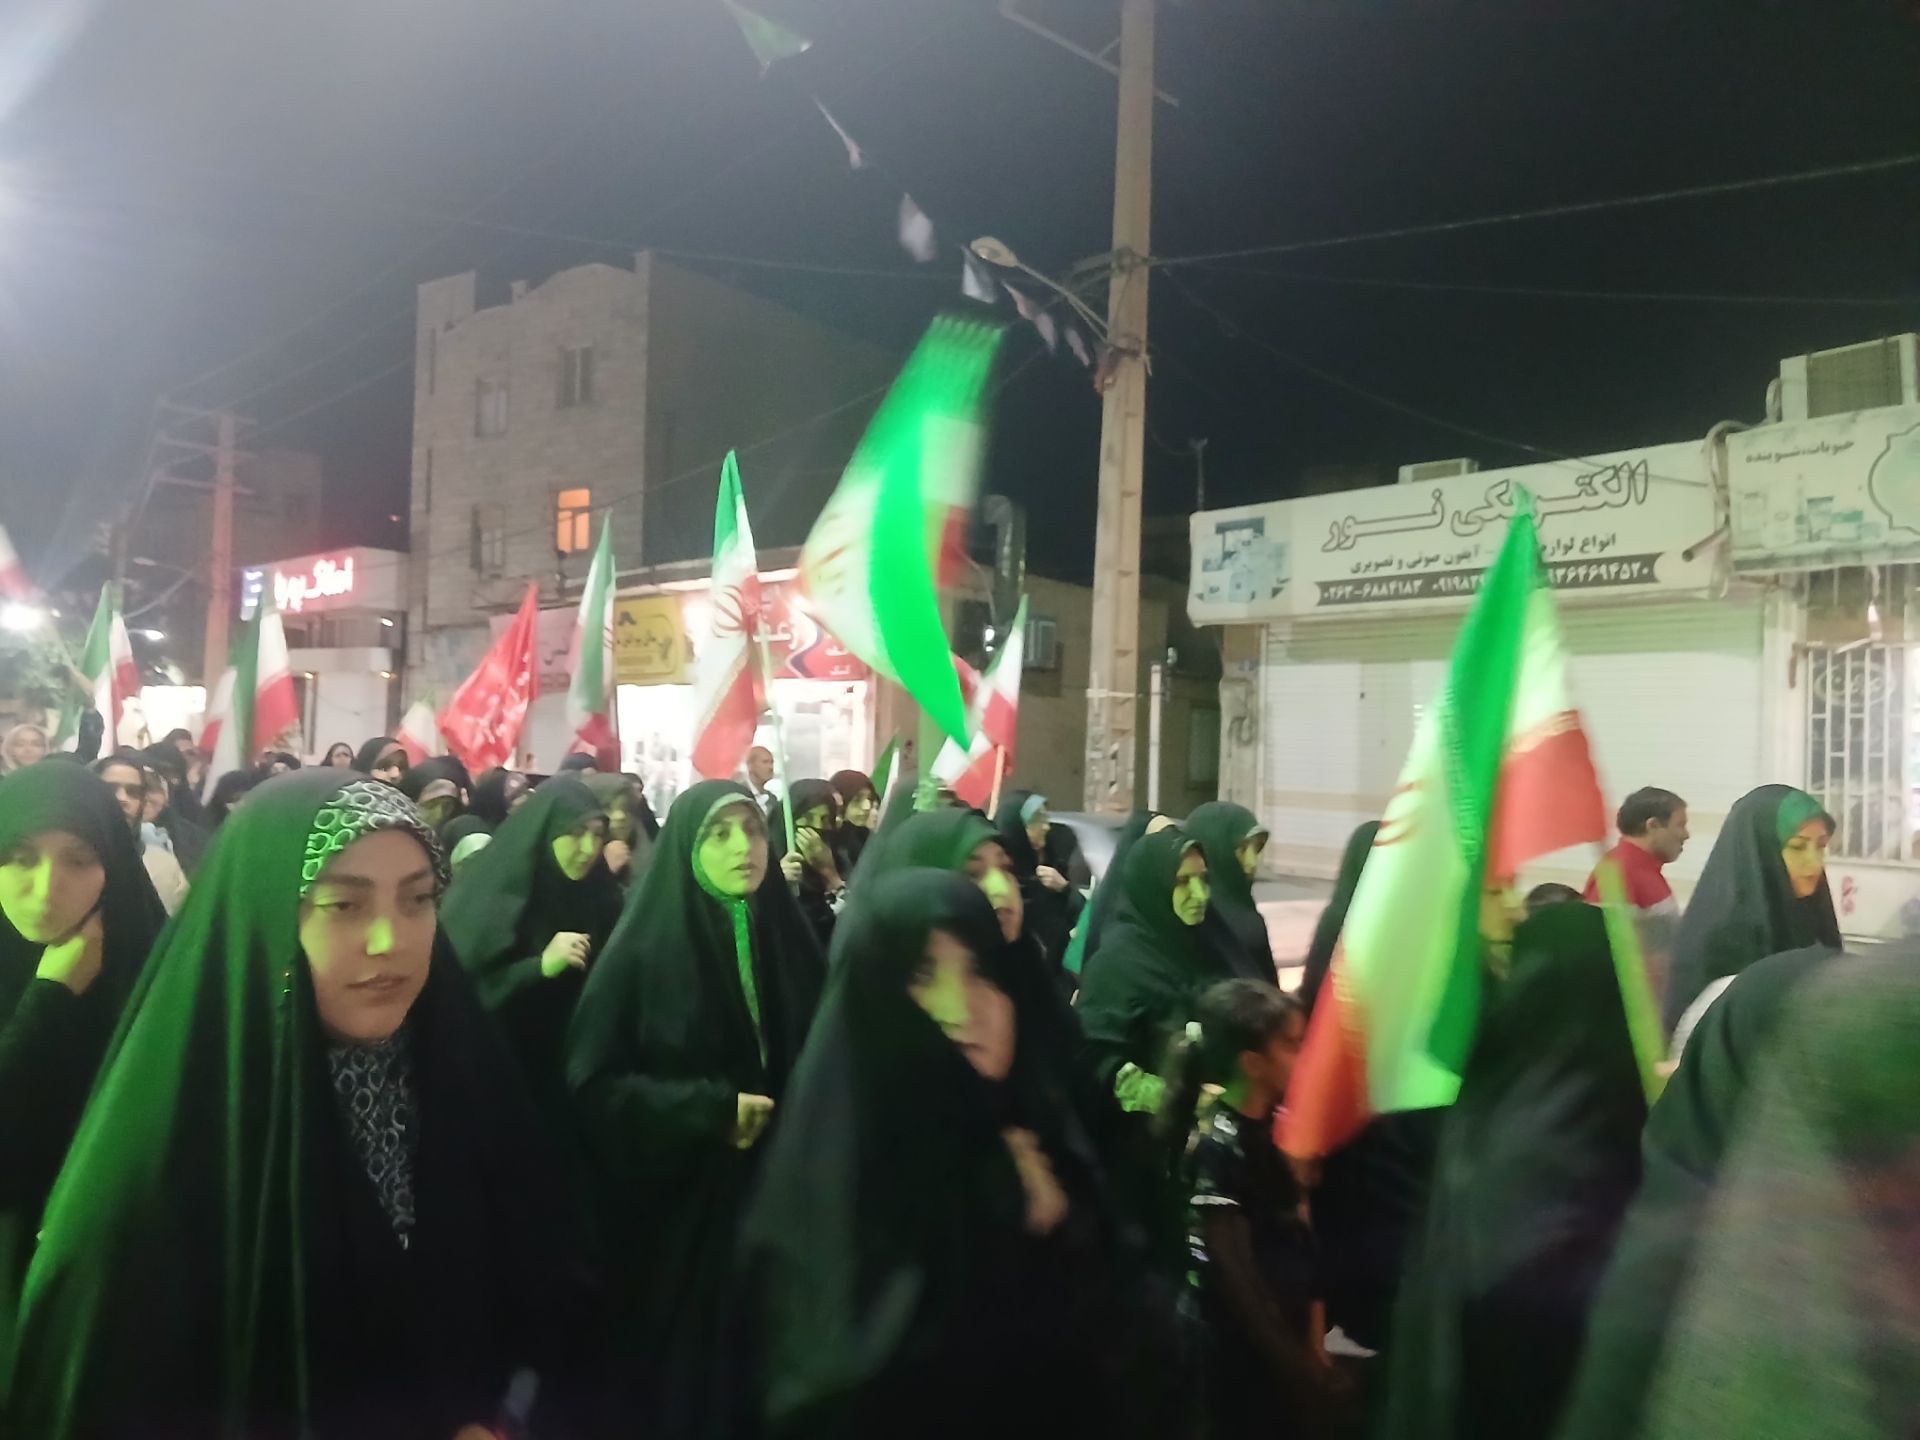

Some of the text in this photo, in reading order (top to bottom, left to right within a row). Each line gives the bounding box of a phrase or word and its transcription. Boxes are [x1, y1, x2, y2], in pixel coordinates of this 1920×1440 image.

[1321, 458, 1649, 552] الکترکی نور
[1443, 543, 1481, 565] آیفون
[1579, 533, 1617, 554] انواع
[1350, 554, 1394, 574] تصویری
[1406, 550, 1440, 569] صوتی
